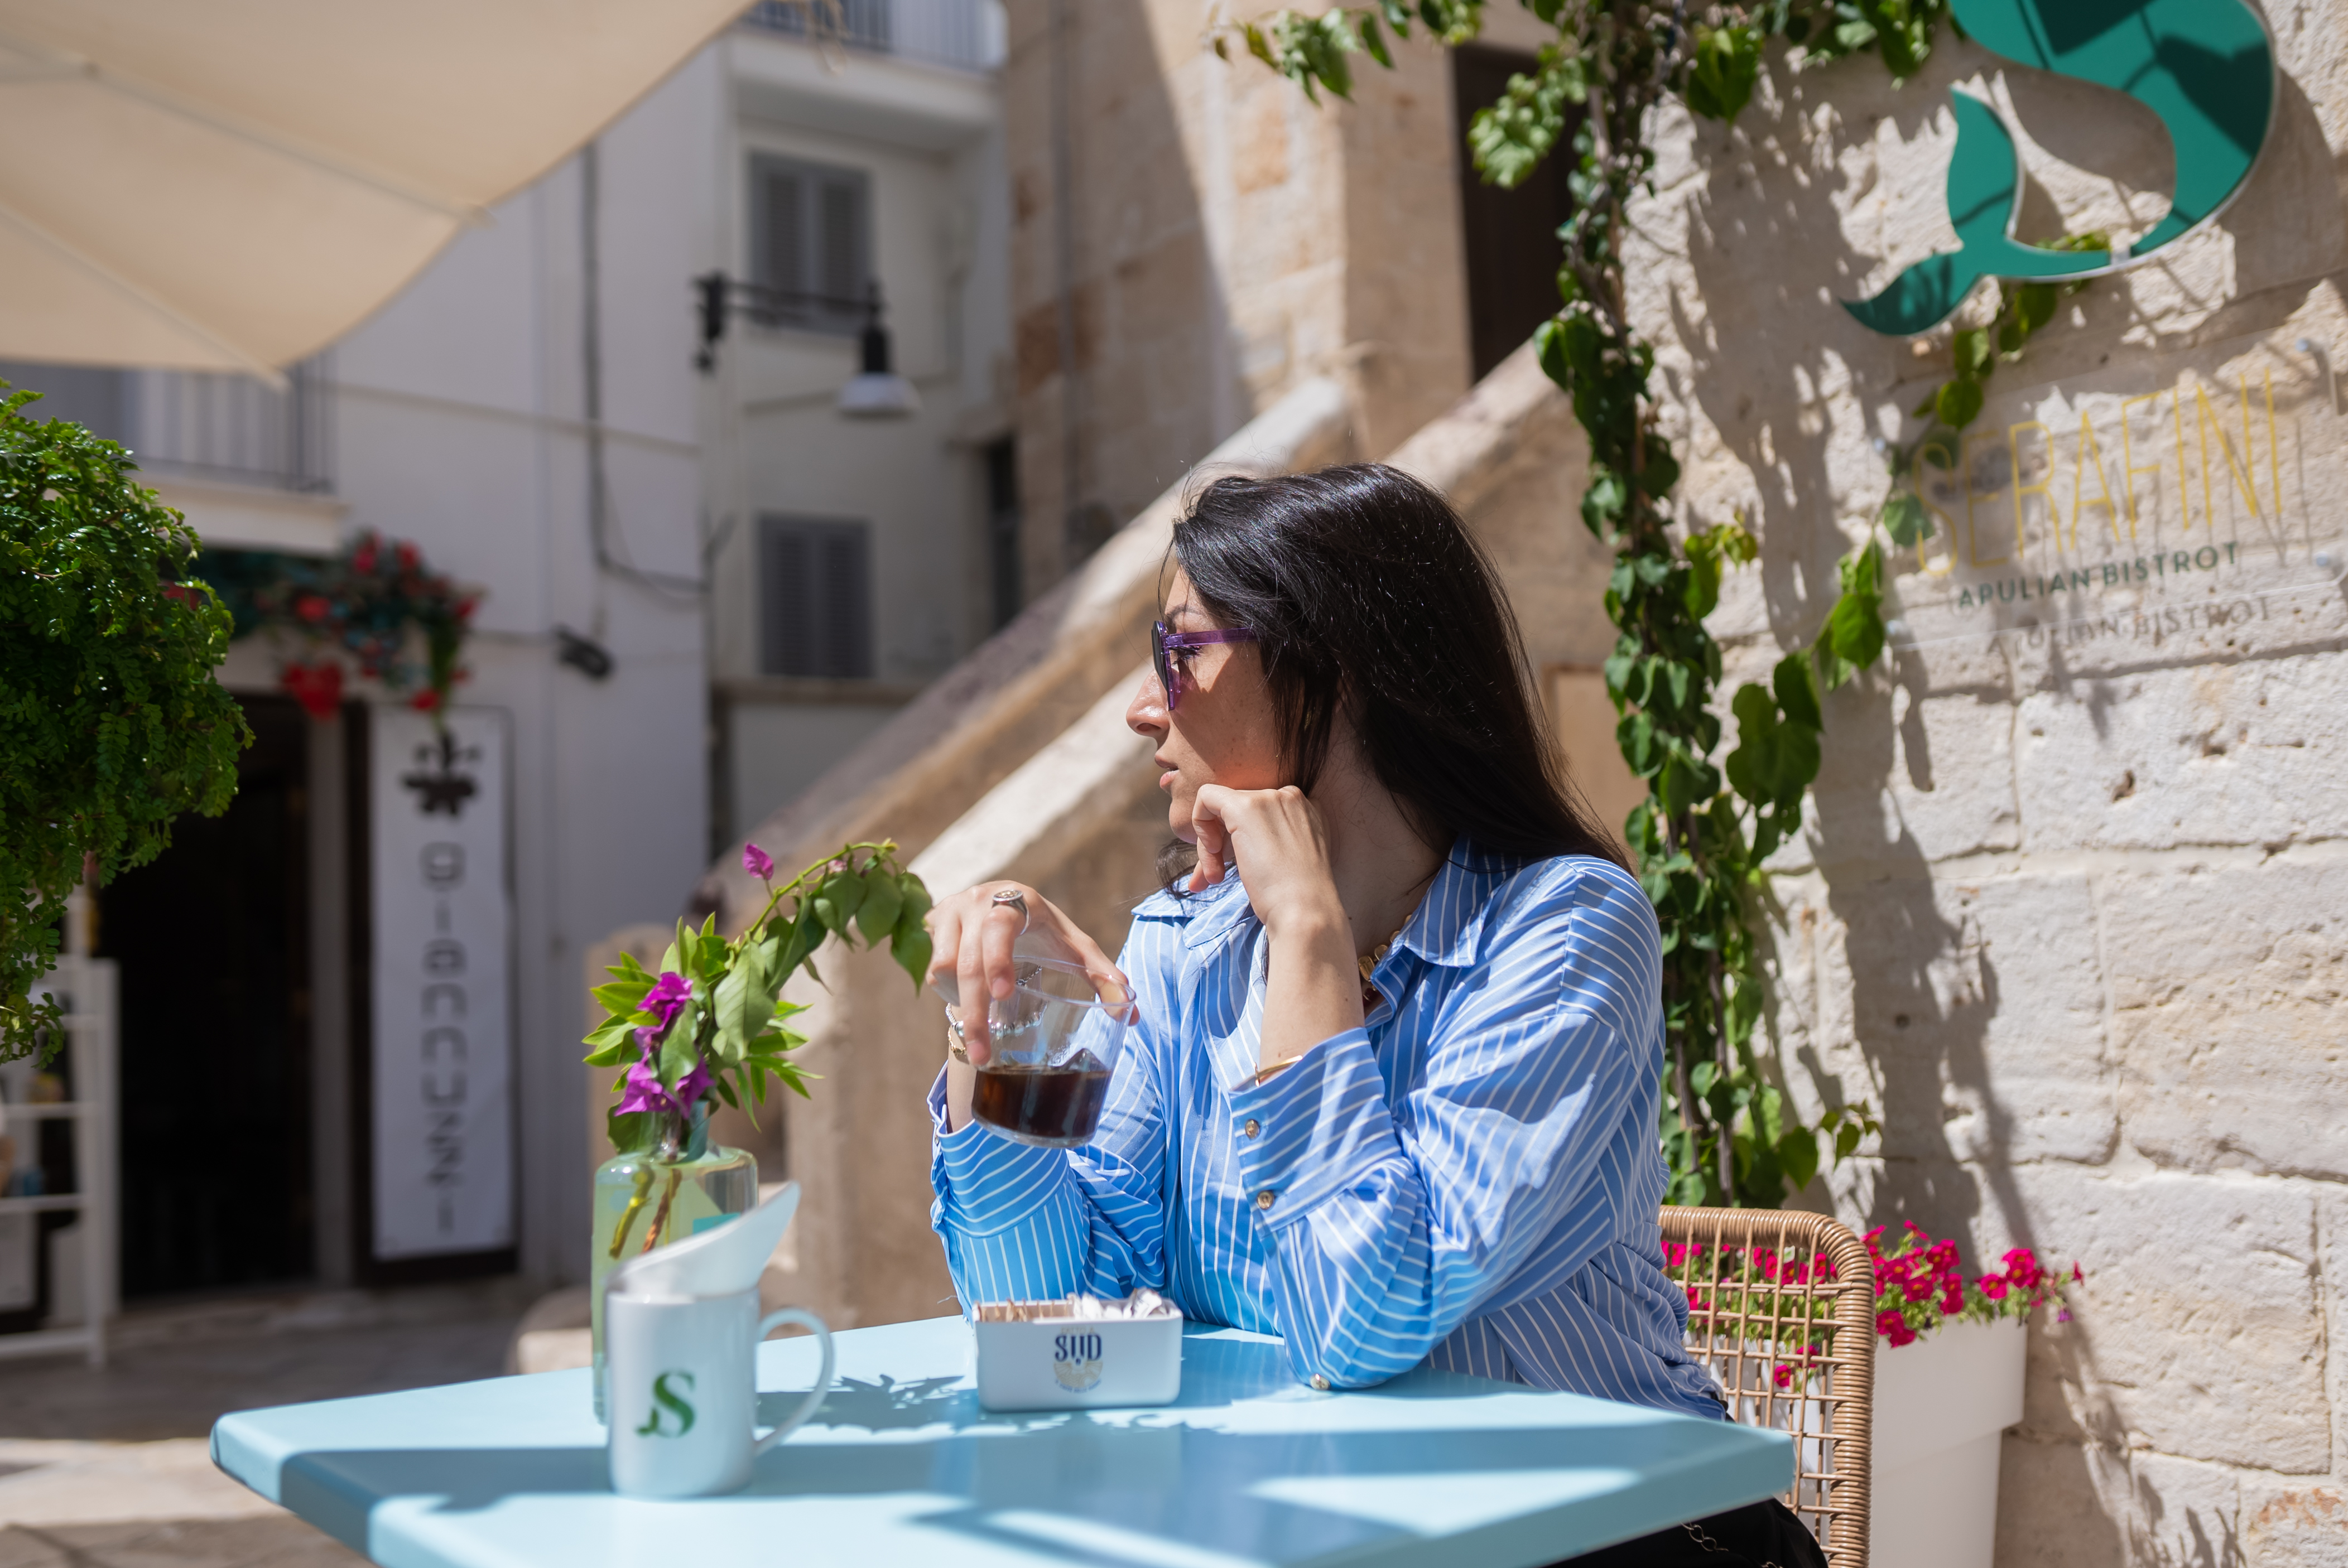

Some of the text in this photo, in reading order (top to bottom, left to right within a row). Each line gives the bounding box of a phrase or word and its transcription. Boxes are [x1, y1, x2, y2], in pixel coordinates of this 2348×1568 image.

[1911, 366, 2282, 577] SERAFINI
[1959, 541, 2239, 609] APULIAN BISTROT
[1055, 1334, 1102, 1366] SUD
